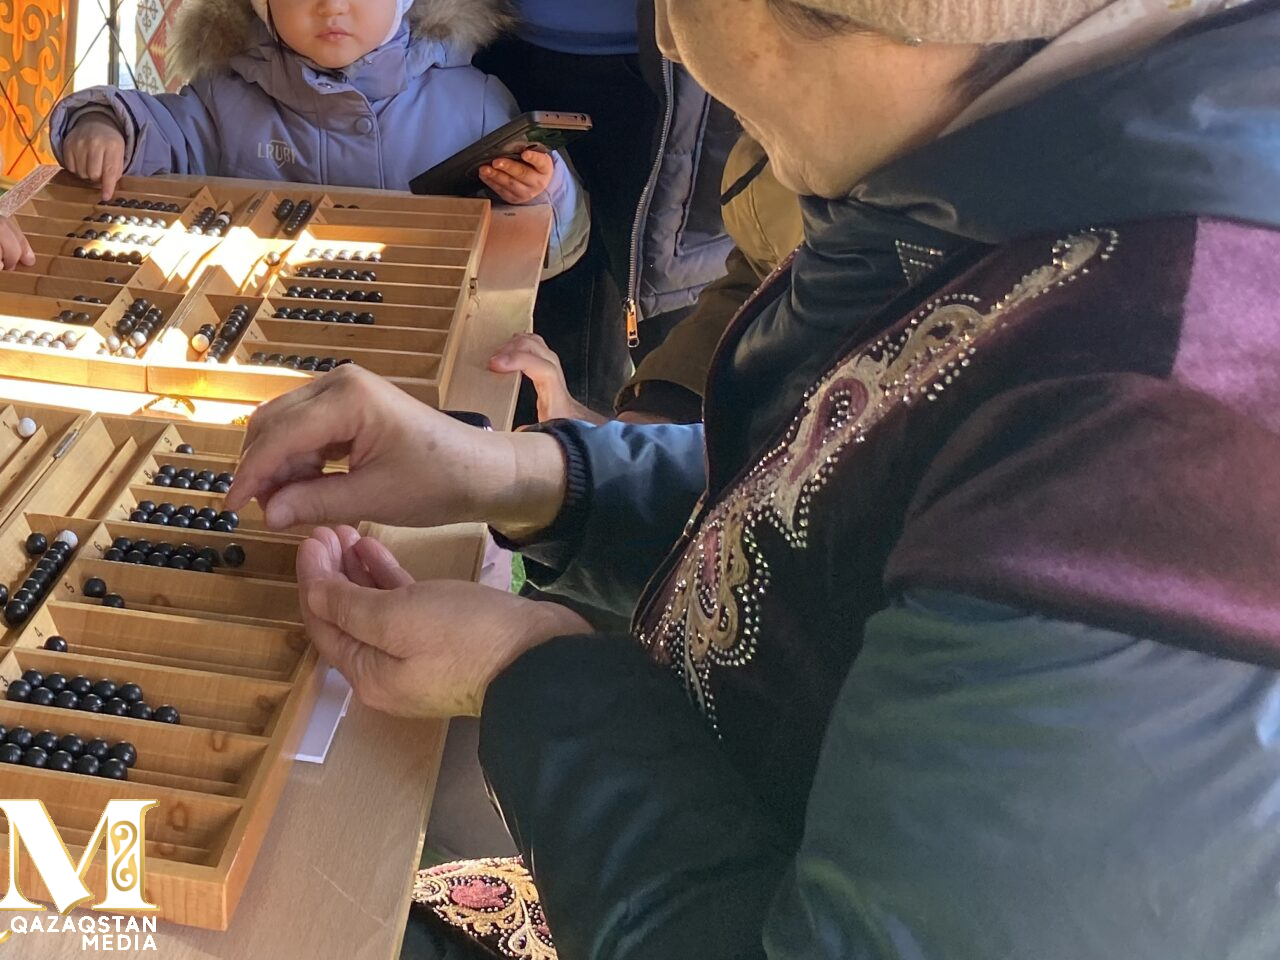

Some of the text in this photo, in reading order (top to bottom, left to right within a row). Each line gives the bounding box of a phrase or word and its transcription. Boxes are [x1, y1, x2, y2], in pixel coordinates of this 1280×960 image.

[94, 541, 103, 552] 6
[64, 582, 74, 593] 5
[34, 627, 43, 638] 4
[0, 675, 9, 688] 3
